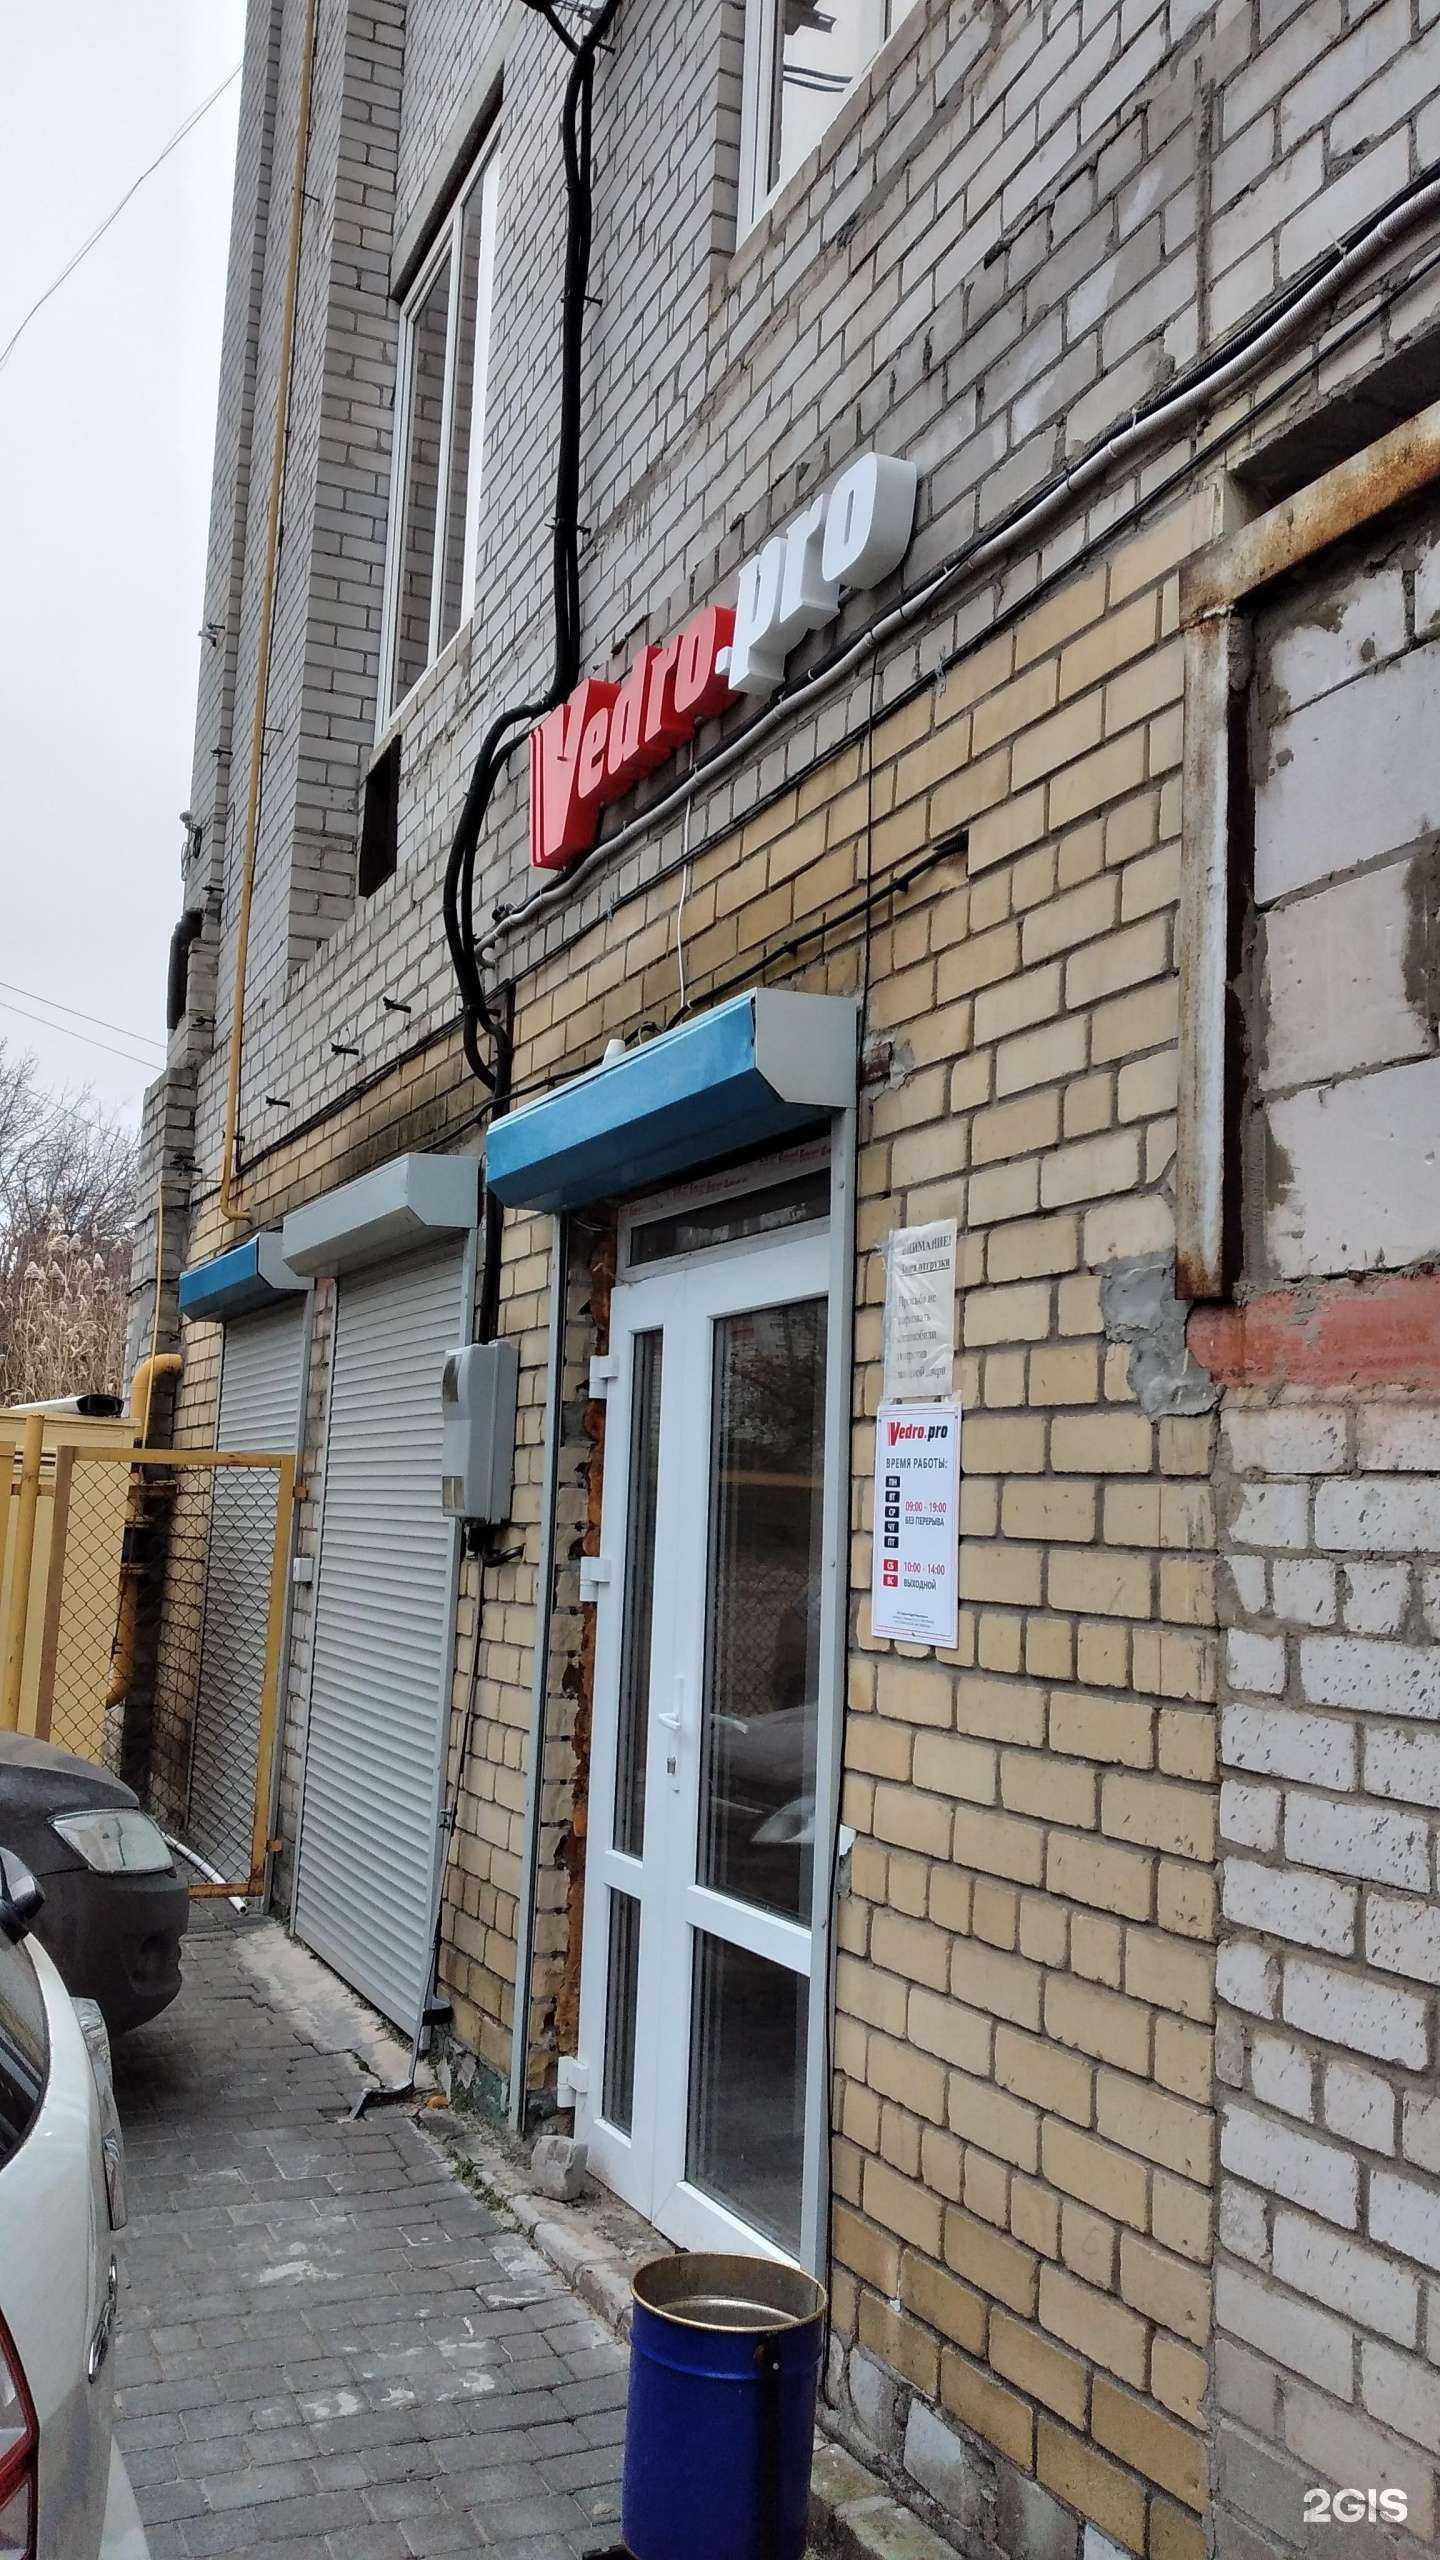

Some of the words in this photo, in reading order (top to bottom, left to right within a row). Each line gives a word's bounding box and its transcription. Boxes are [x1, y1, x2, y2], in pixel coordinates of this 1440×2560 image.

[529, 452, 915, 869] Vedro.pro
[887, 1421, 948, 1446] Vedro.pro
[886, 1457, 911, 1469] ВРЕМЯ
[913, 1457, 948, 1469] РАБОТЫ:
[888, 1478, 898, 1487] ПН
[905, 1500, 923, 1512] 09:00
[929, 1502, 947, 1512] 19:00
[904, 1516, 915, 1525] БЕЗ
[904, 1561, 921, 1573] 10:00
[927, 1563, 945, 1575] 14:00
[903, 1578, 937, 1590] ВЫХОДНОЙ
